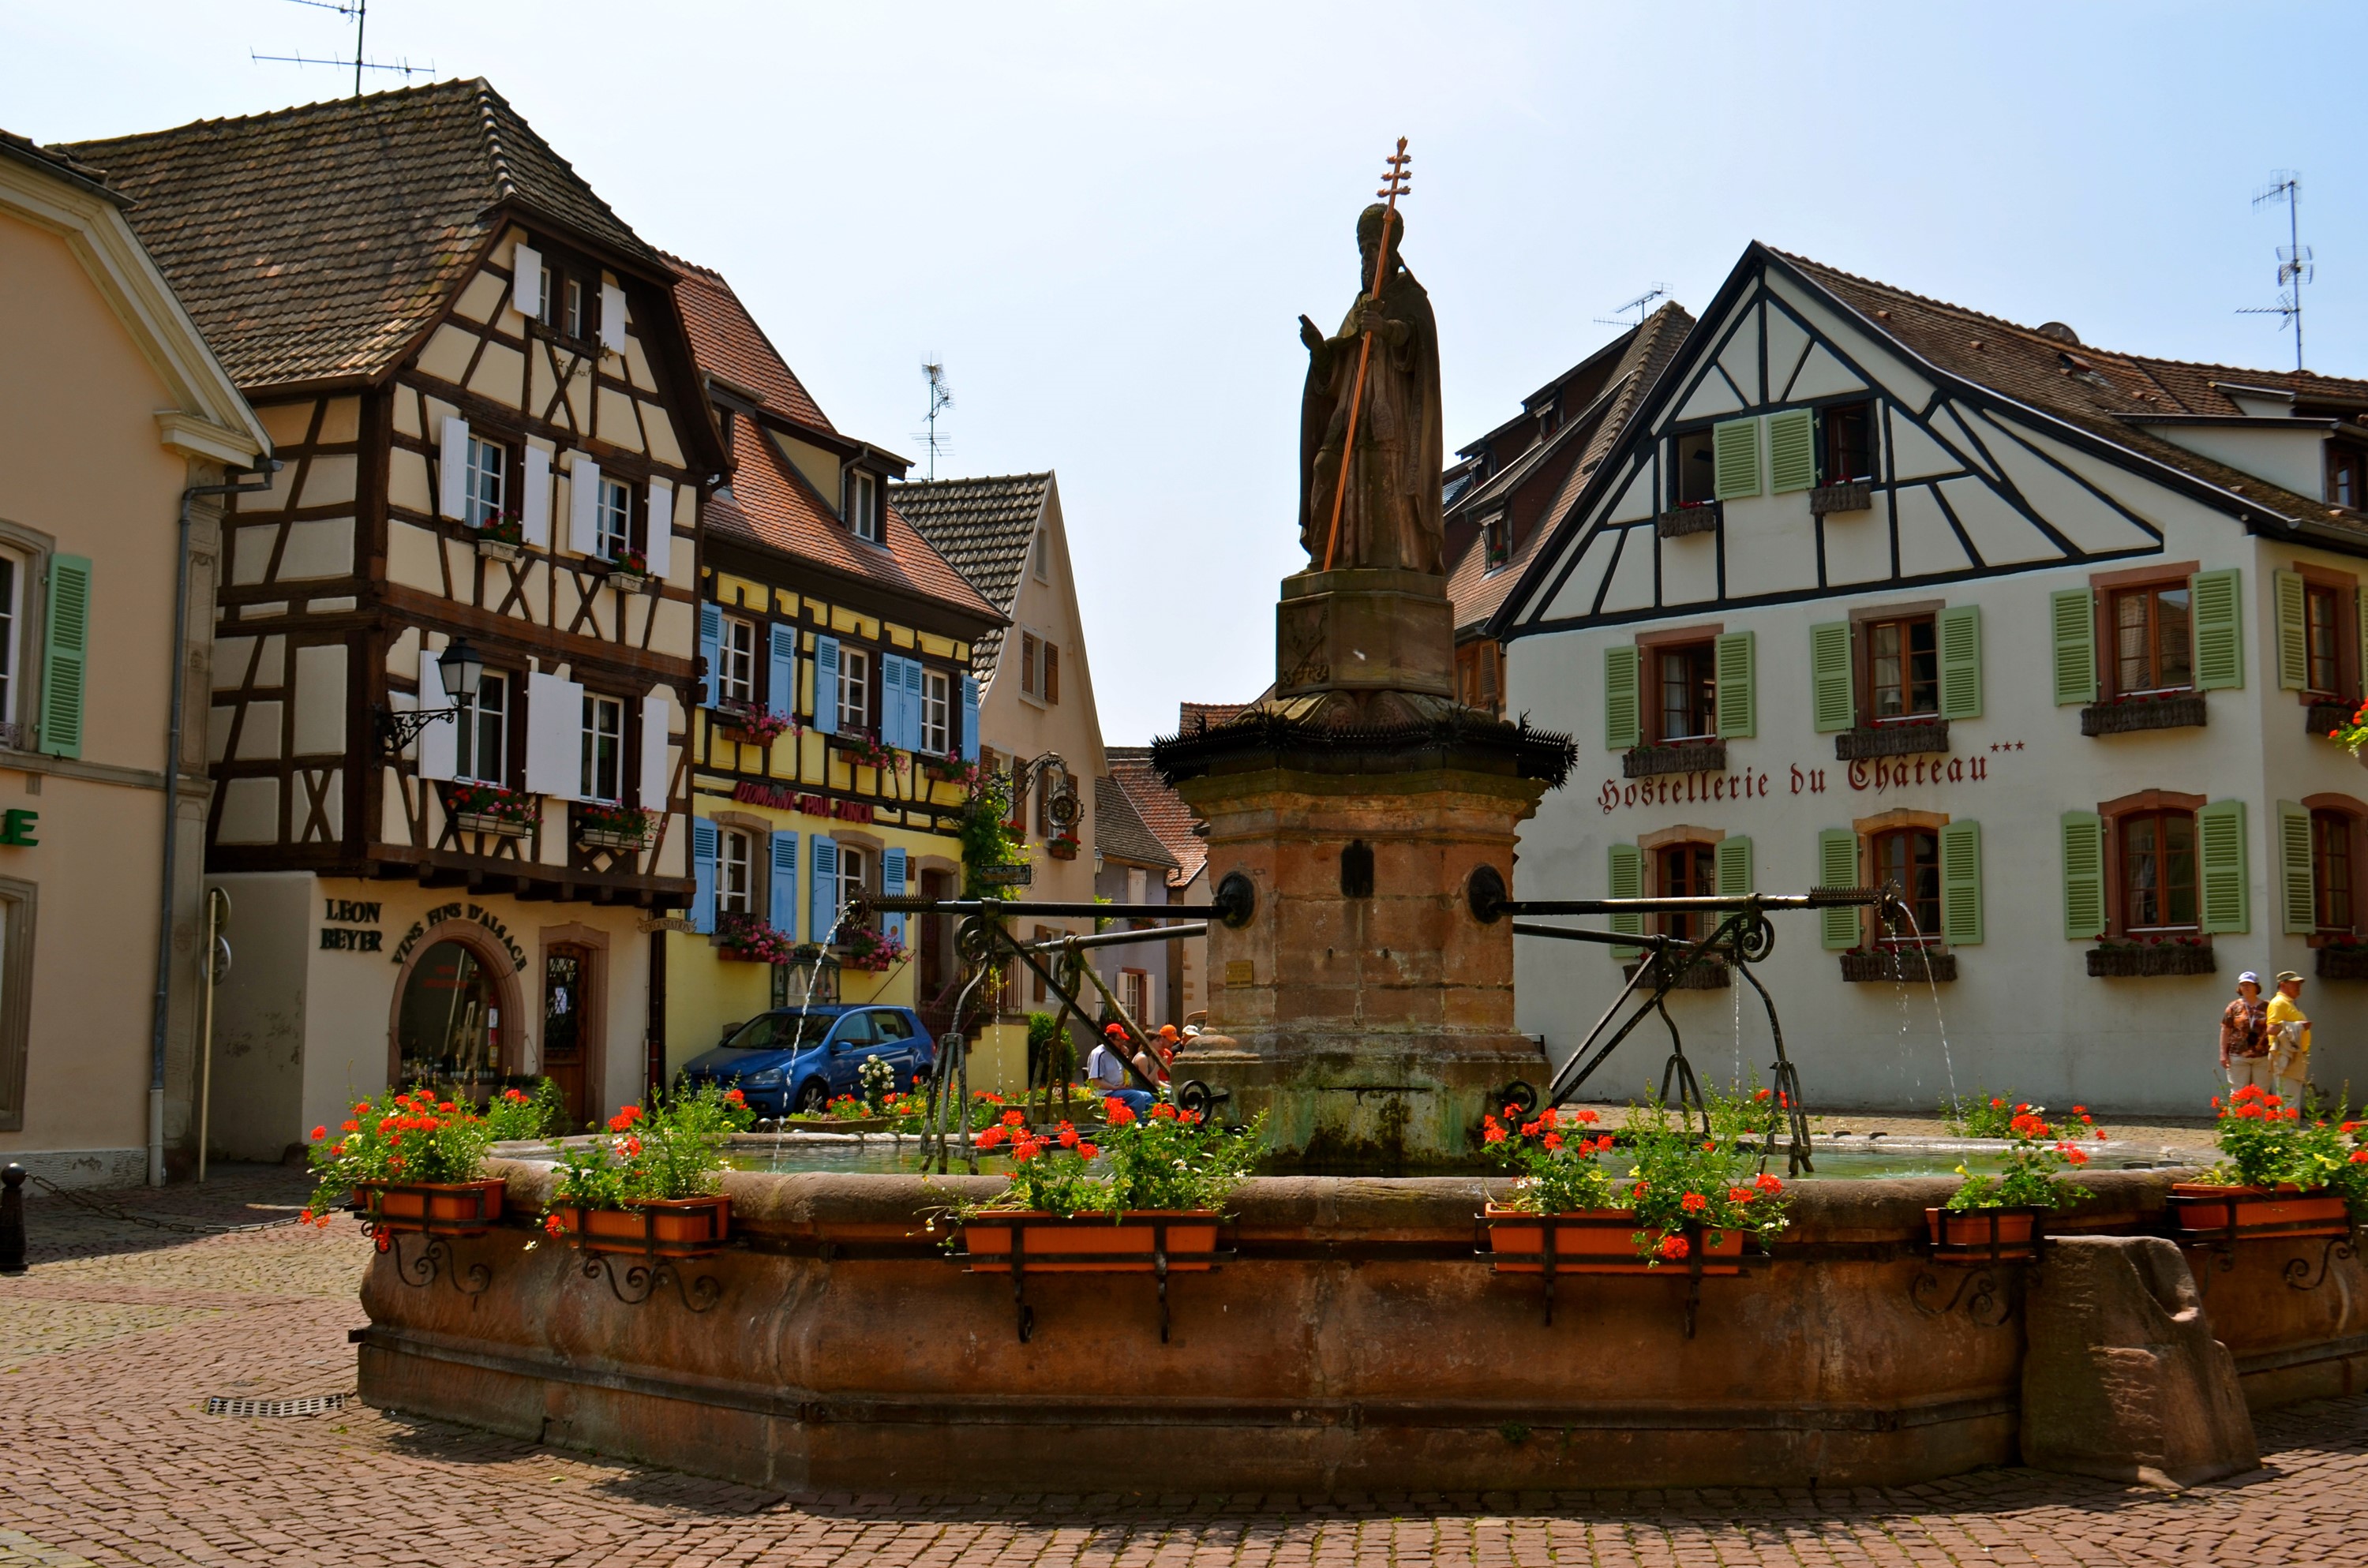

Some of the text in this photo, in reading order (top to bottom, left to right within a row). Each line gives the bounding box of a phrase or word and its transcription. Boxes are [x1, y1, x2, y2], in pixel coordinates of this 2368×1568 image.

[733, 780, 874, 824] DOMAINE PAUL ZINCK
[1597, 754, 1988, 815] Hostellerie du Château
[0, 808, 39, 847] E
[324, 898, 383, 924] LEON
[319, 927, 384, 952] BEYER
[392, 902, 528, 972] VINS FINS D'ALSACE
